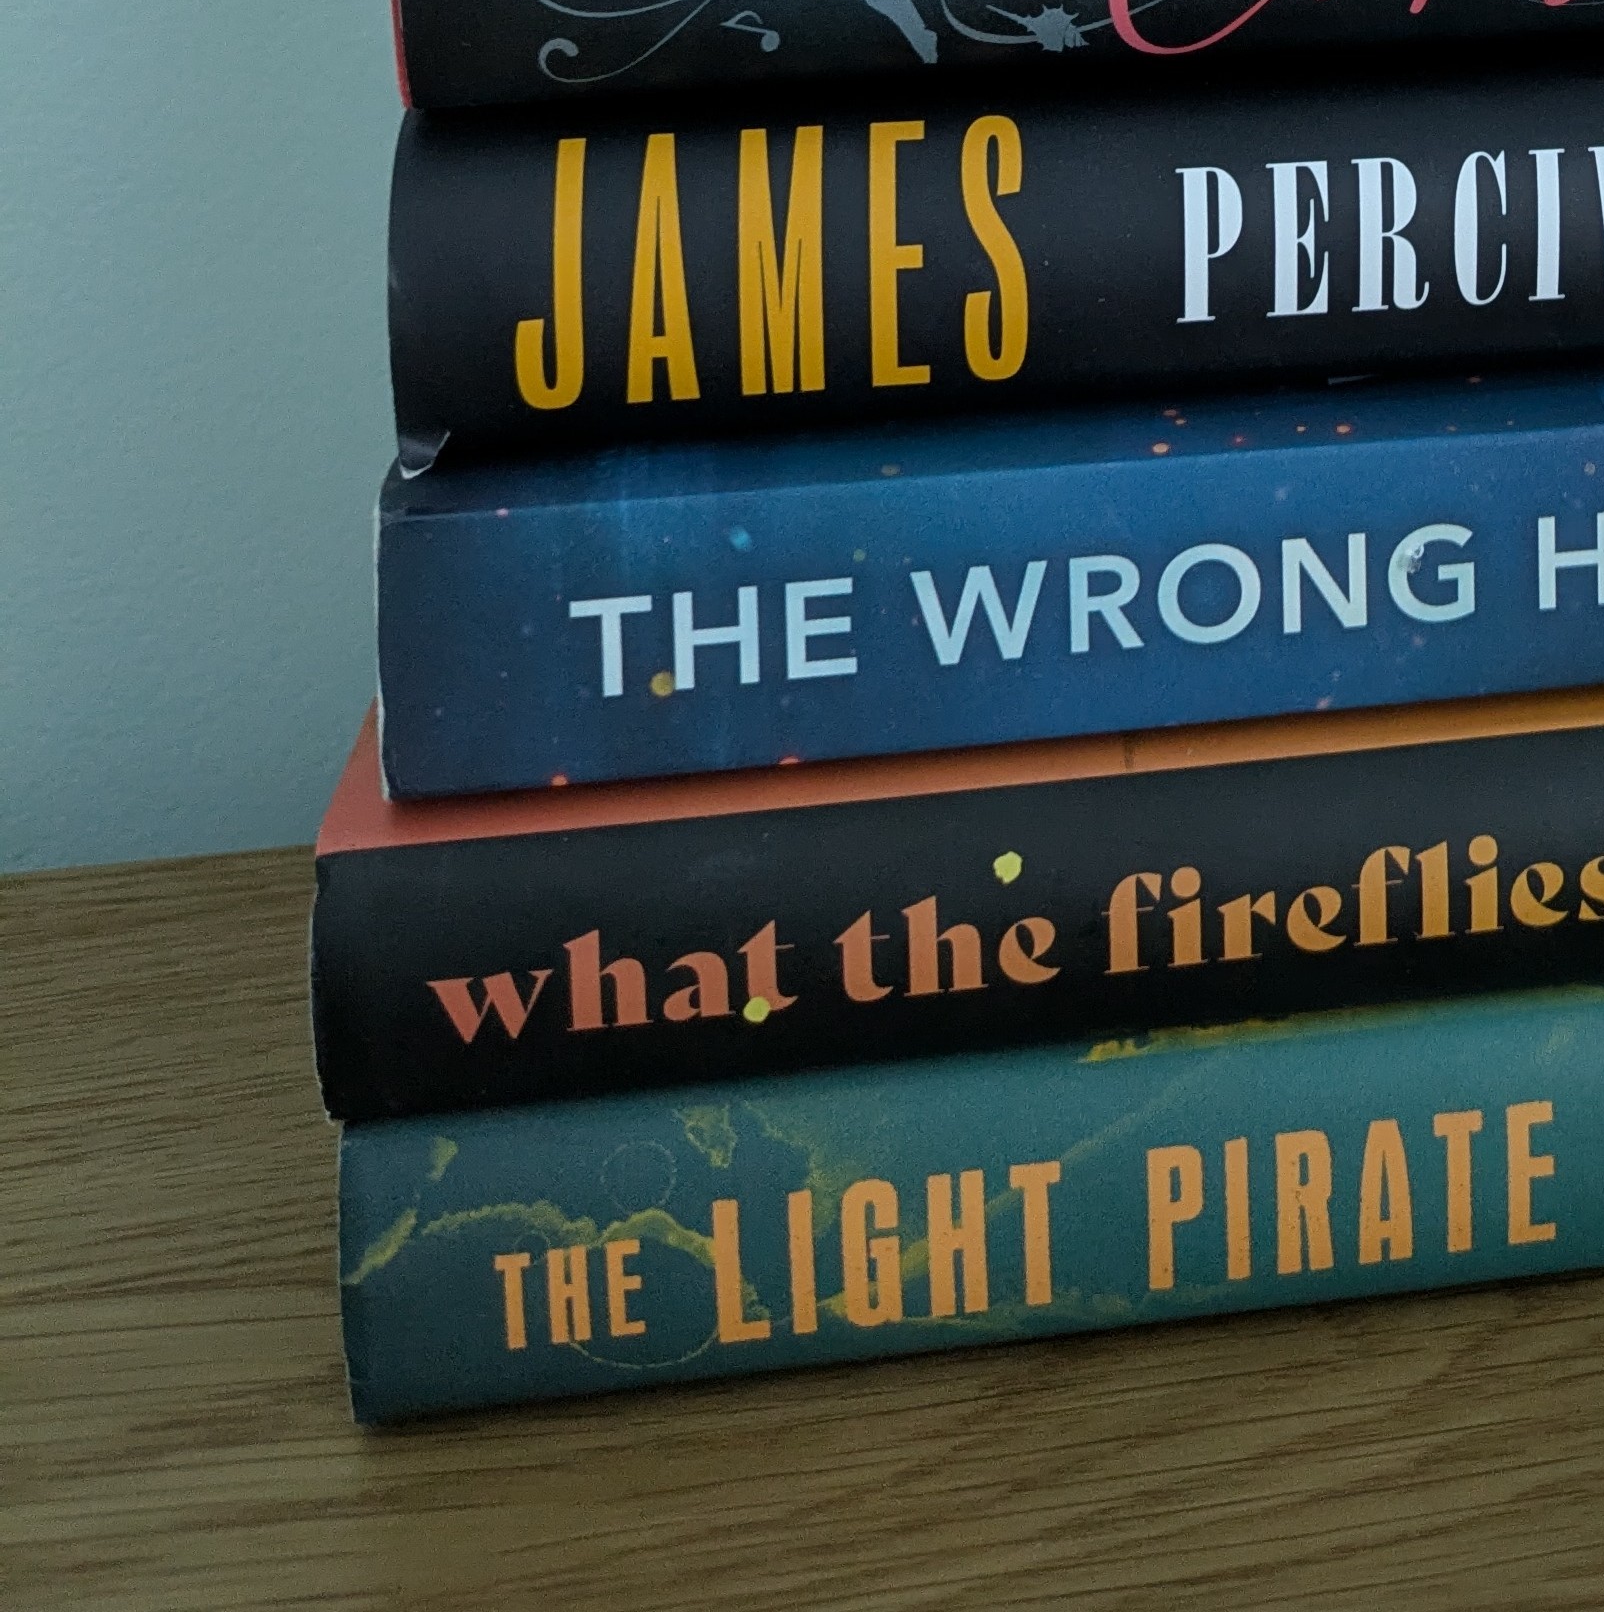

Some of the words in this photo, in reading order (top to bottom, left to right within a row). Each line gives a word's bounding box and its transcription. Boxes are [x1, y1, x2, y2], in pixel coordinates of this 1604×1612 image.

[515, 114, 1030, 411] JAMES
[569, 576, 860, 699] THE
[912, 523, 1476, 668] WRONG
[425, 920, 797, 1045] what
[833, 895, 1062, 1004] the
[493, 1237, 649, 1351] THE
[711, 1160, 1062, 1346] LIGHT
[1146, 1099, 1557, 1292] PIRATE
